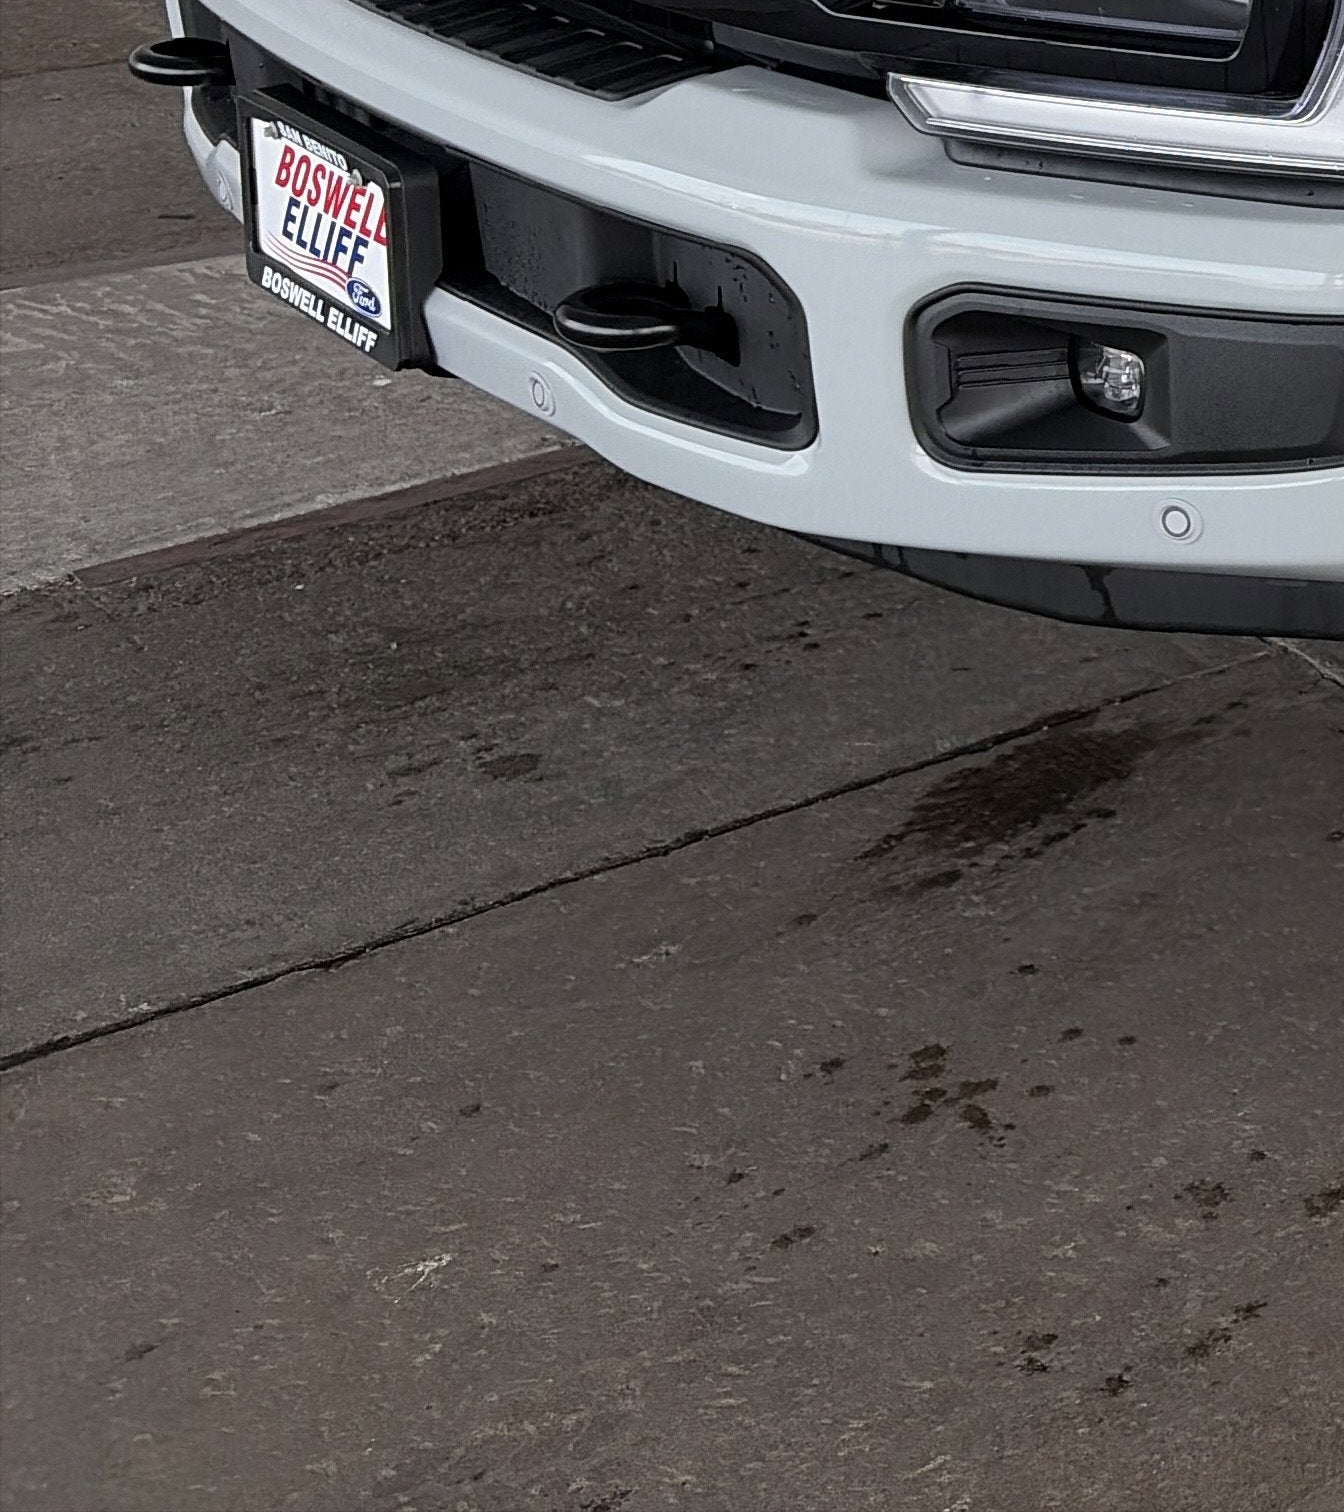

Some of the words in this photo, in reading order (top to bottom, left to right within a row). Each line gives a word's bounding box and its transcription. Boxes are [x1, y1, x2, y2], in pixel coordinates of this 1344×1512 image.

[277, 120, 303, 147] SAN
[301, 134, 348, 171] BENITO
[275, 144, 388, 246] BOSWELL
[281, 195, 369, 278] ELLIFF
[261, 266, 325, 322] BOSWELL
[326, 306, 378, 353] ELLIFF
[352, 282, 376, 312] Ford
